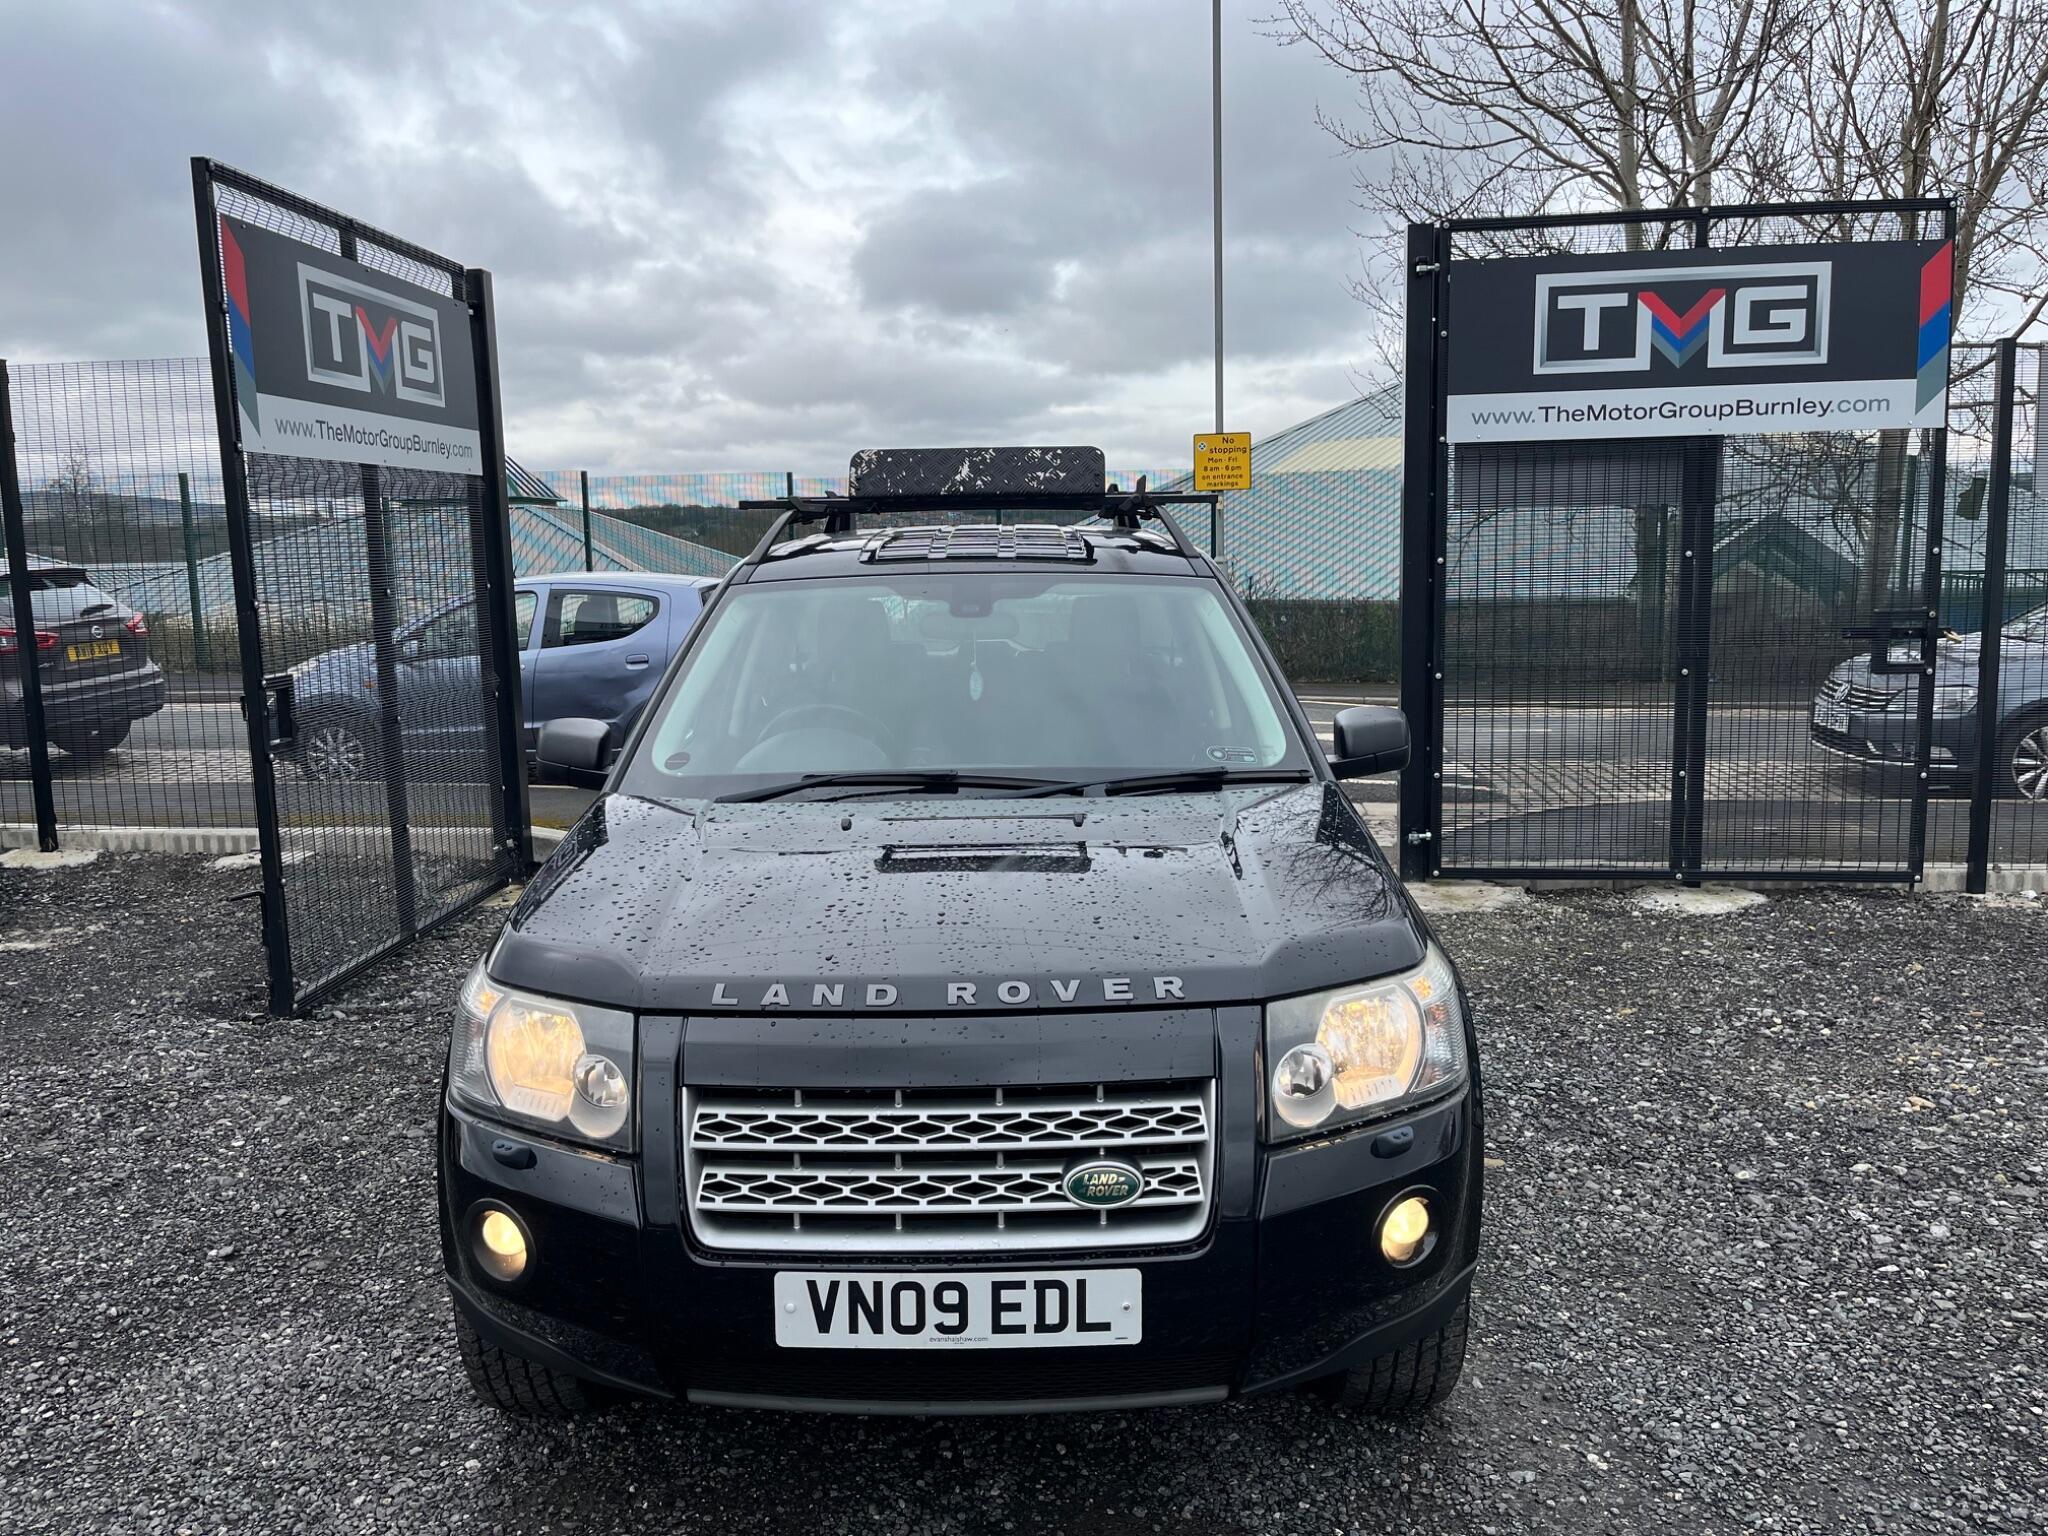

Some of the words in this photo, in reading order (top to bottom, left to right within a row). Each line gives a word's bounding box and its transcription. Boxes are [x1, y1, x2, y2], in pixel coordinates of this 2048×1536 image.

[312, 292, 435, 395] TMG
[1556, 284, 1808, 368] TMG
[1471, 397, 1890, 426] www.TheMotorGroupBurnley.com
[275, 418, 473, 459] www.TheMotorGroupBurnley.com
[1209, 446, 1247, 454] stopping
[711, 983, 899, 1007] LAND
[946, 976, 1186, 1005] ROVER
[1087, 1185, 1129, 1197] ROVER
[806, 1280, 969, 1335] VN09
[990, 1278, 1112, 1335] EDL
